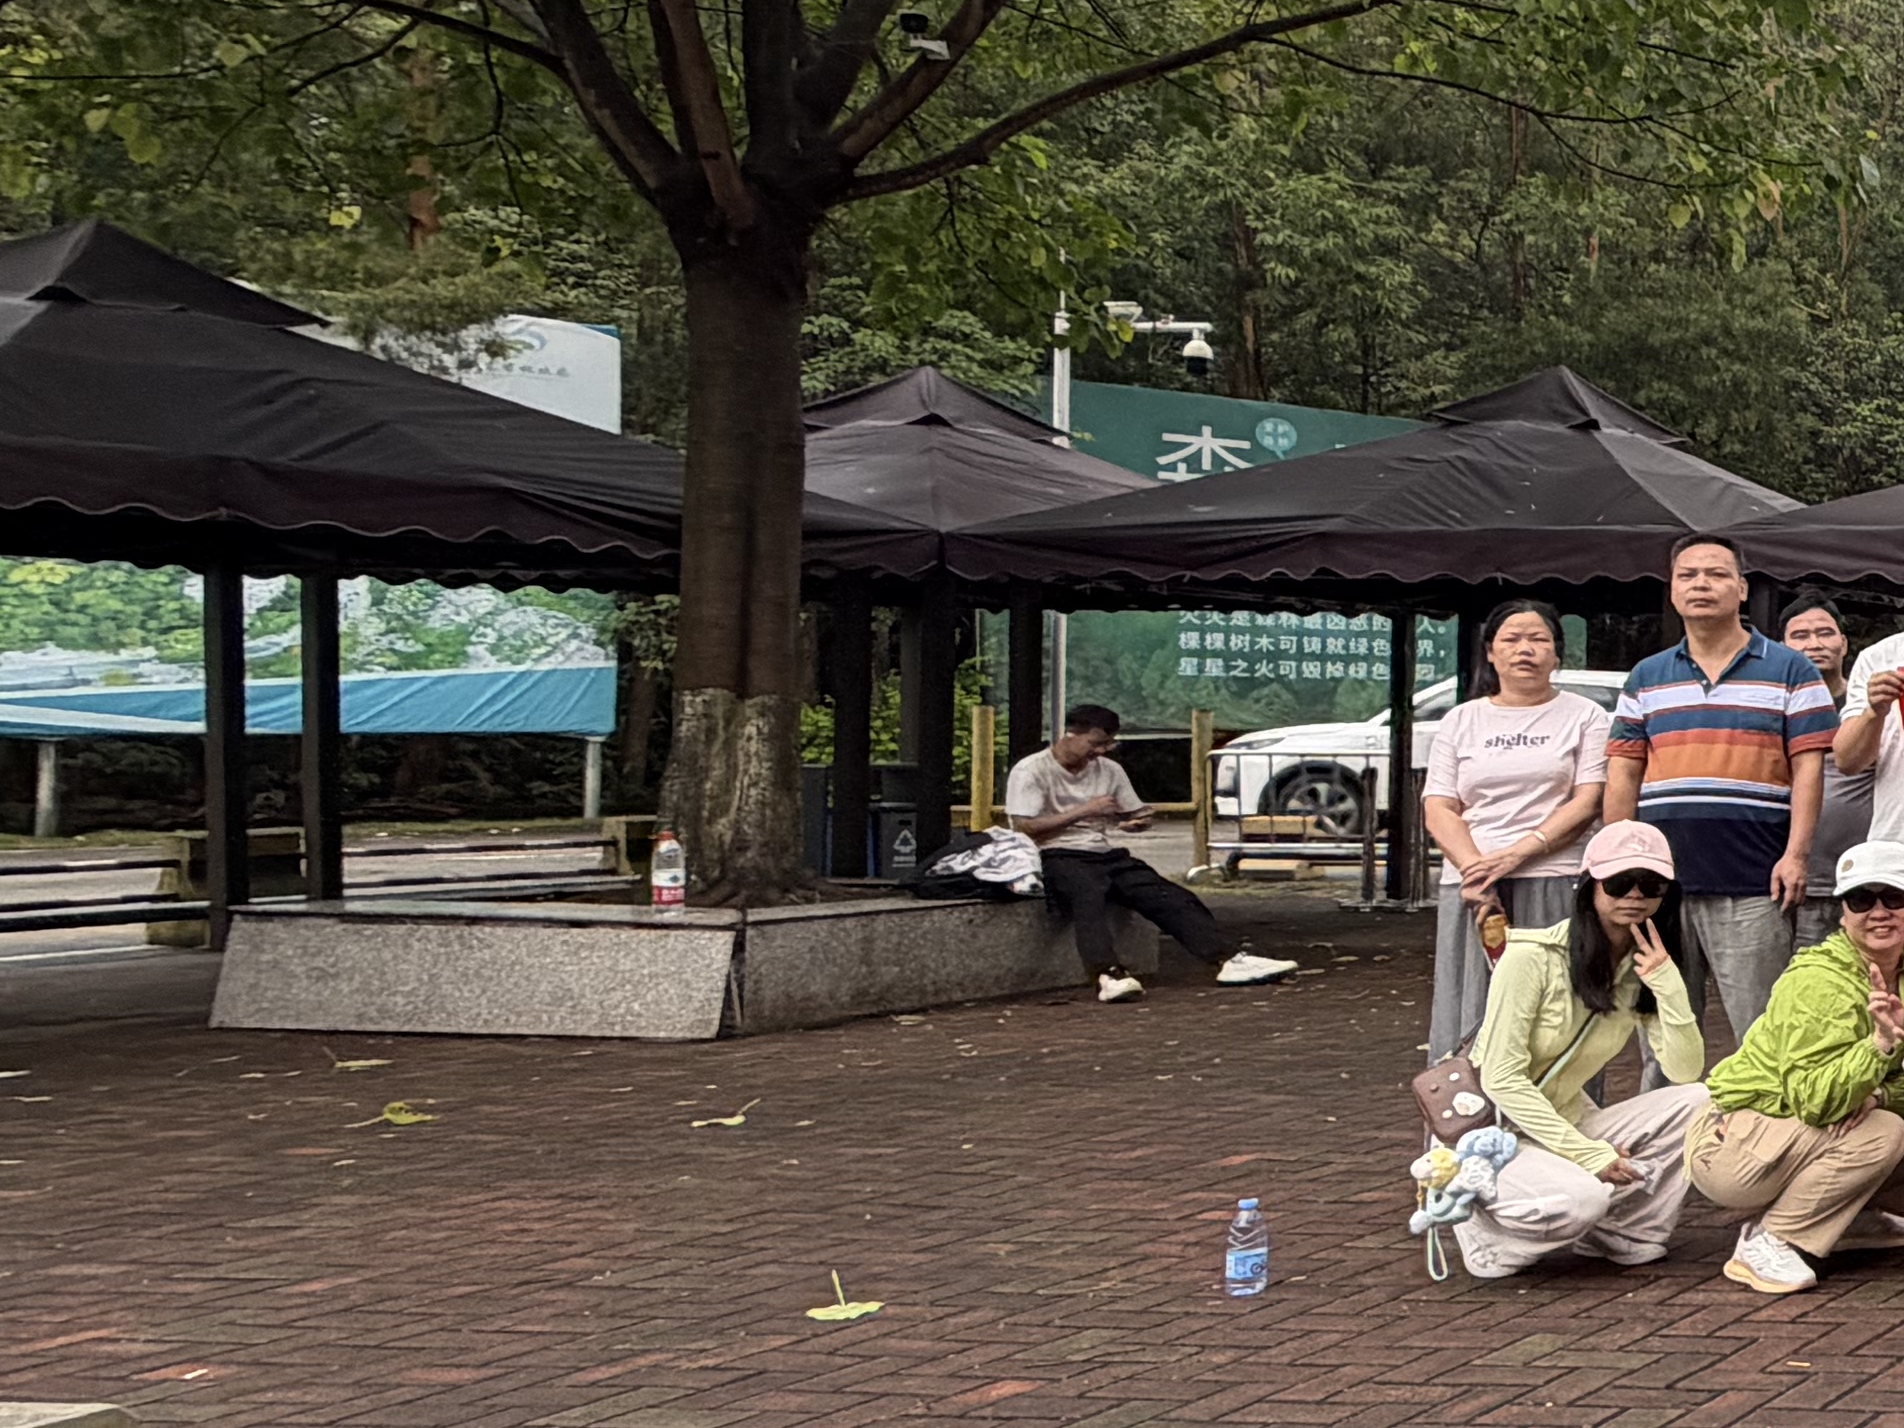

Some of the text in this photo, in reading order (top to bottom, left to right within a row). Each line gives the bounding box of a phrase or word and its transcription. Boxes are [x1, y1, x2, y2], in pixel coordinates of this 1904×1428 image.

[1178, 632, 1446, 659] 棵棵树木可铸就绿色界，
